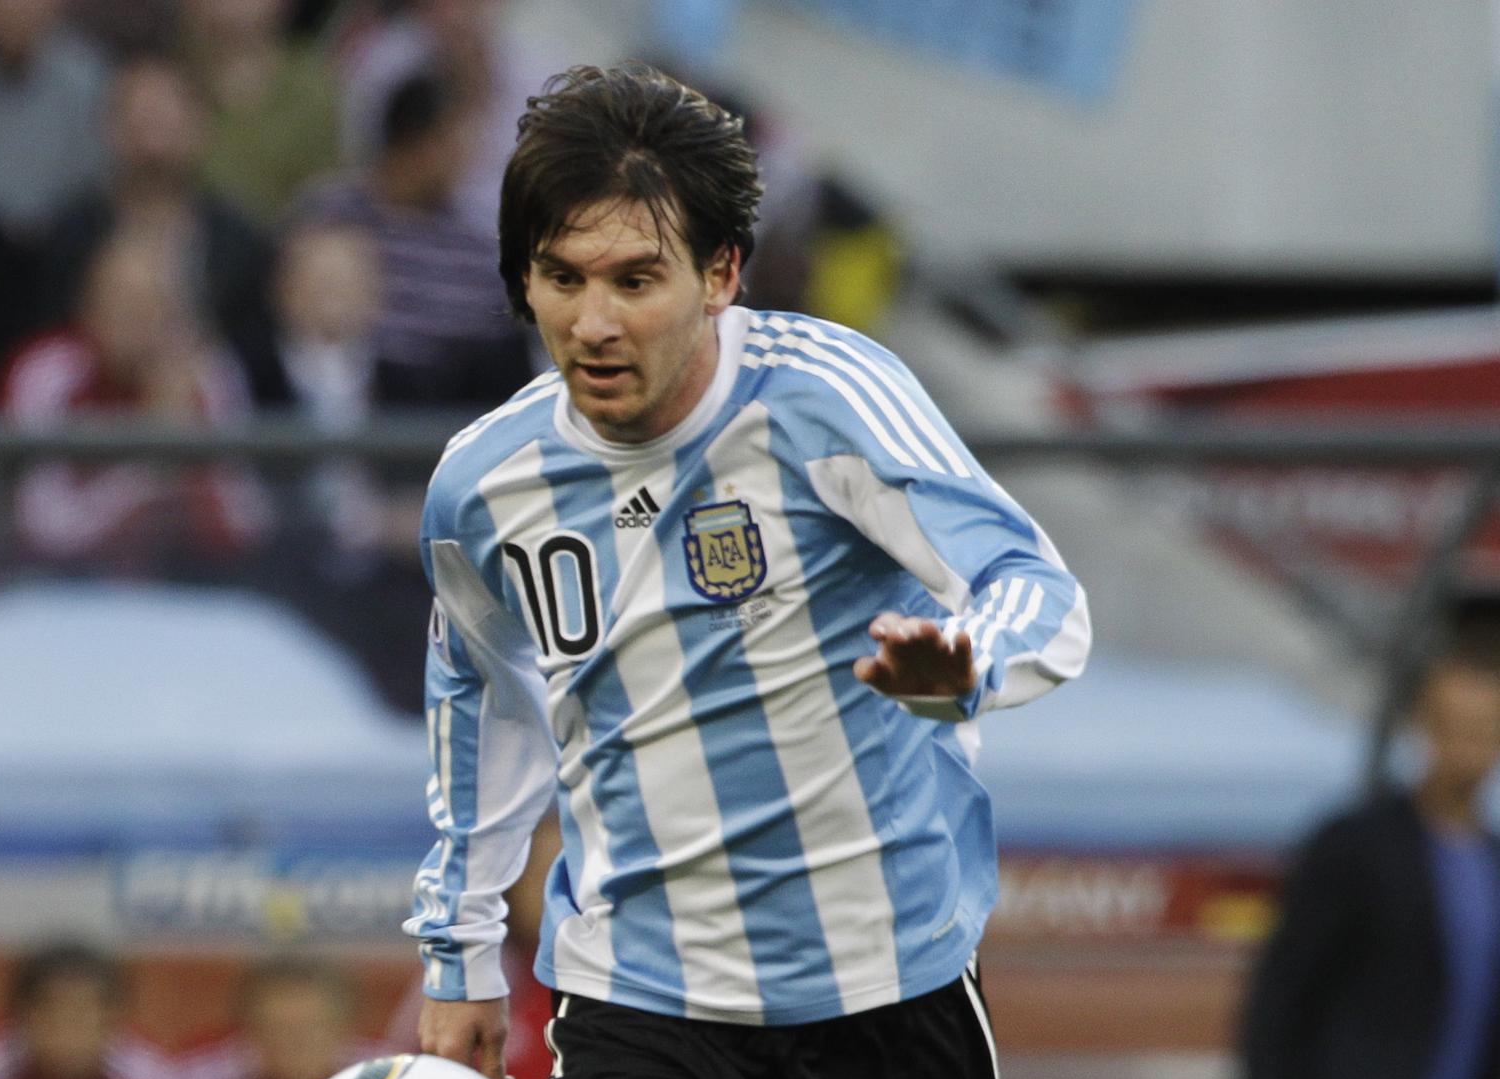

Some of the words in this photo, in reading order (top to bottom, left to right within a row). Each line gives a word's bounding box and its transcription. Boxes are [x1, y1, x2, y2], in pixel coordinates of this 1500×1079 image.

[614, 511, 653, 529] adid
[706, 529, 746, 570] AFA
[500, 534, 600, 657] 10
